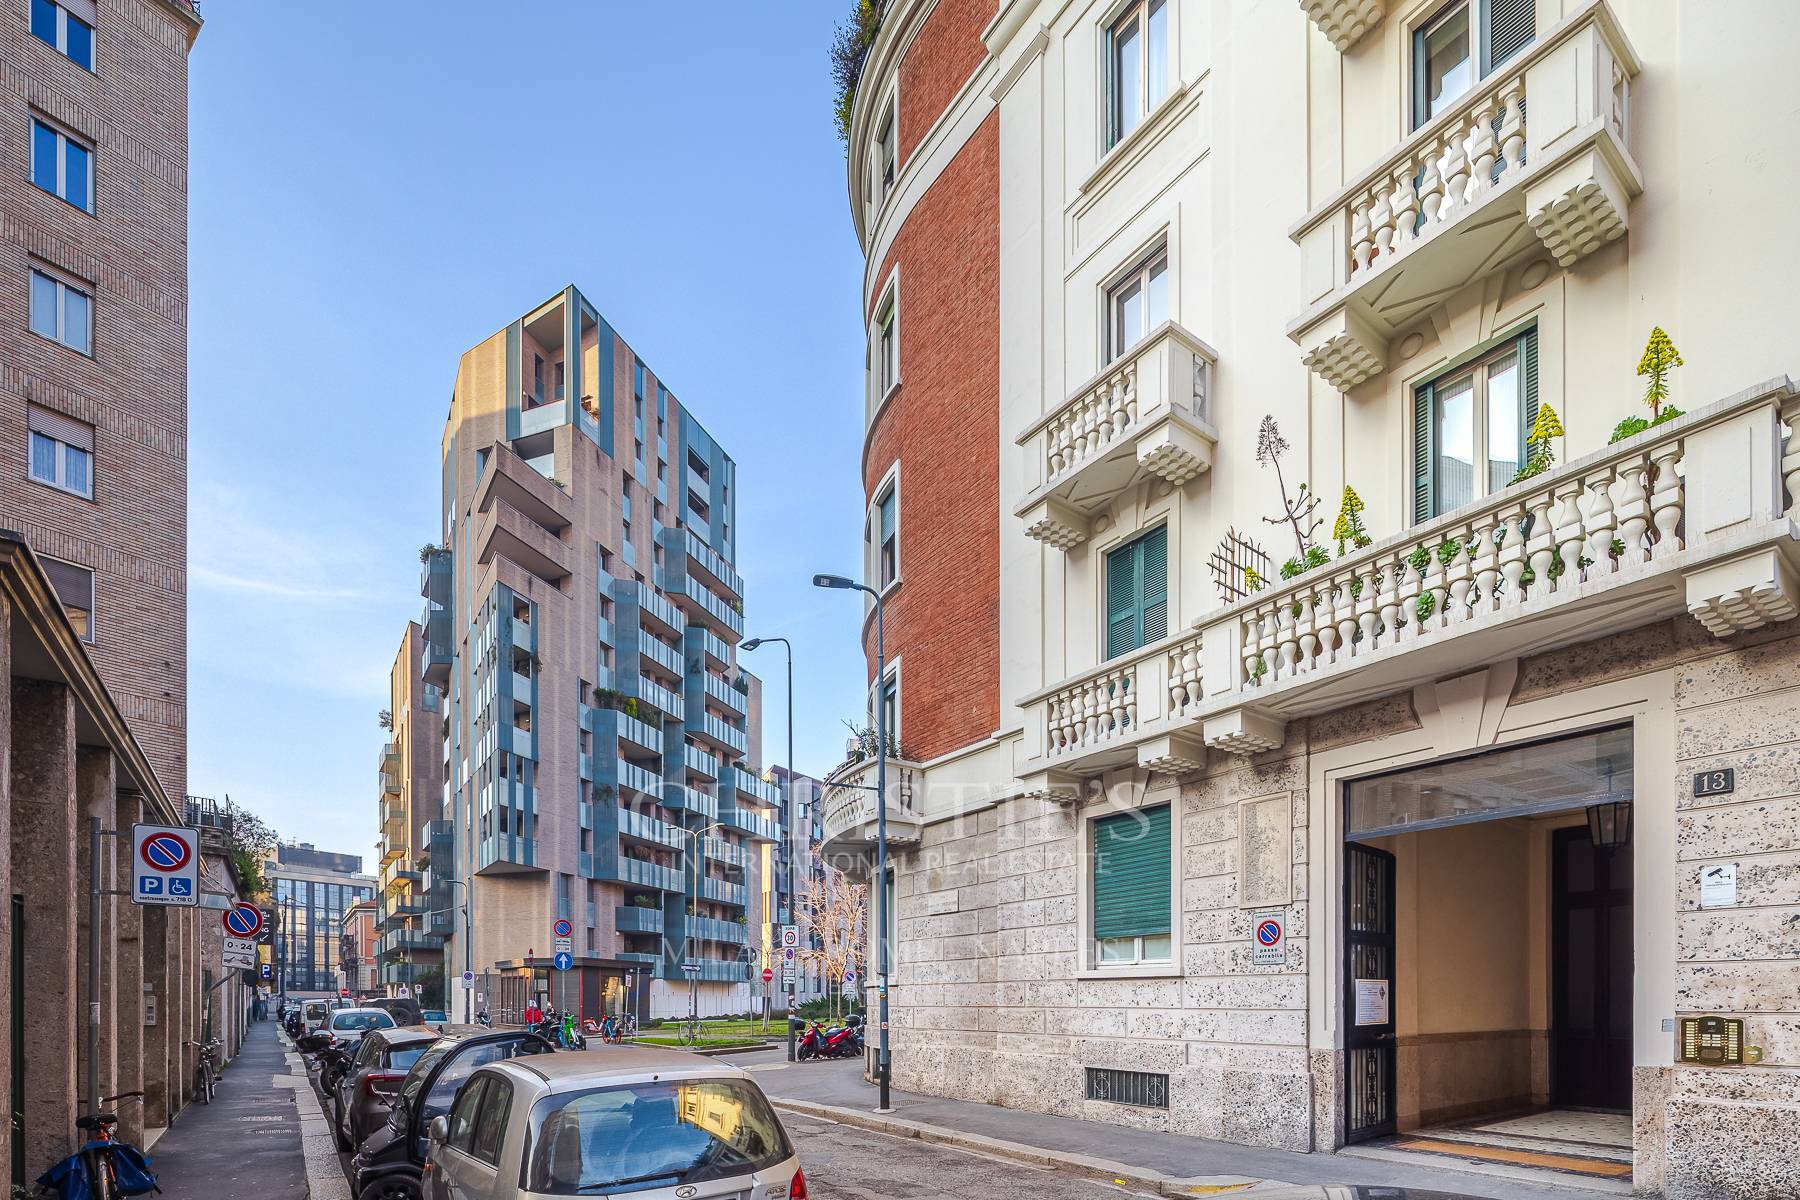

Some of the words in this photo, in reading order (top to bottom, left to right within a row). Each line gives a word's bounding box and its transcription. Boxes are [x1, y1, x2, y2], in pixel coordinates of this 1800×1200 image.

[1701, 772, 1725, 792] 13
[144, 878, 158, 892] P
[262, 965, 270, 974] P
